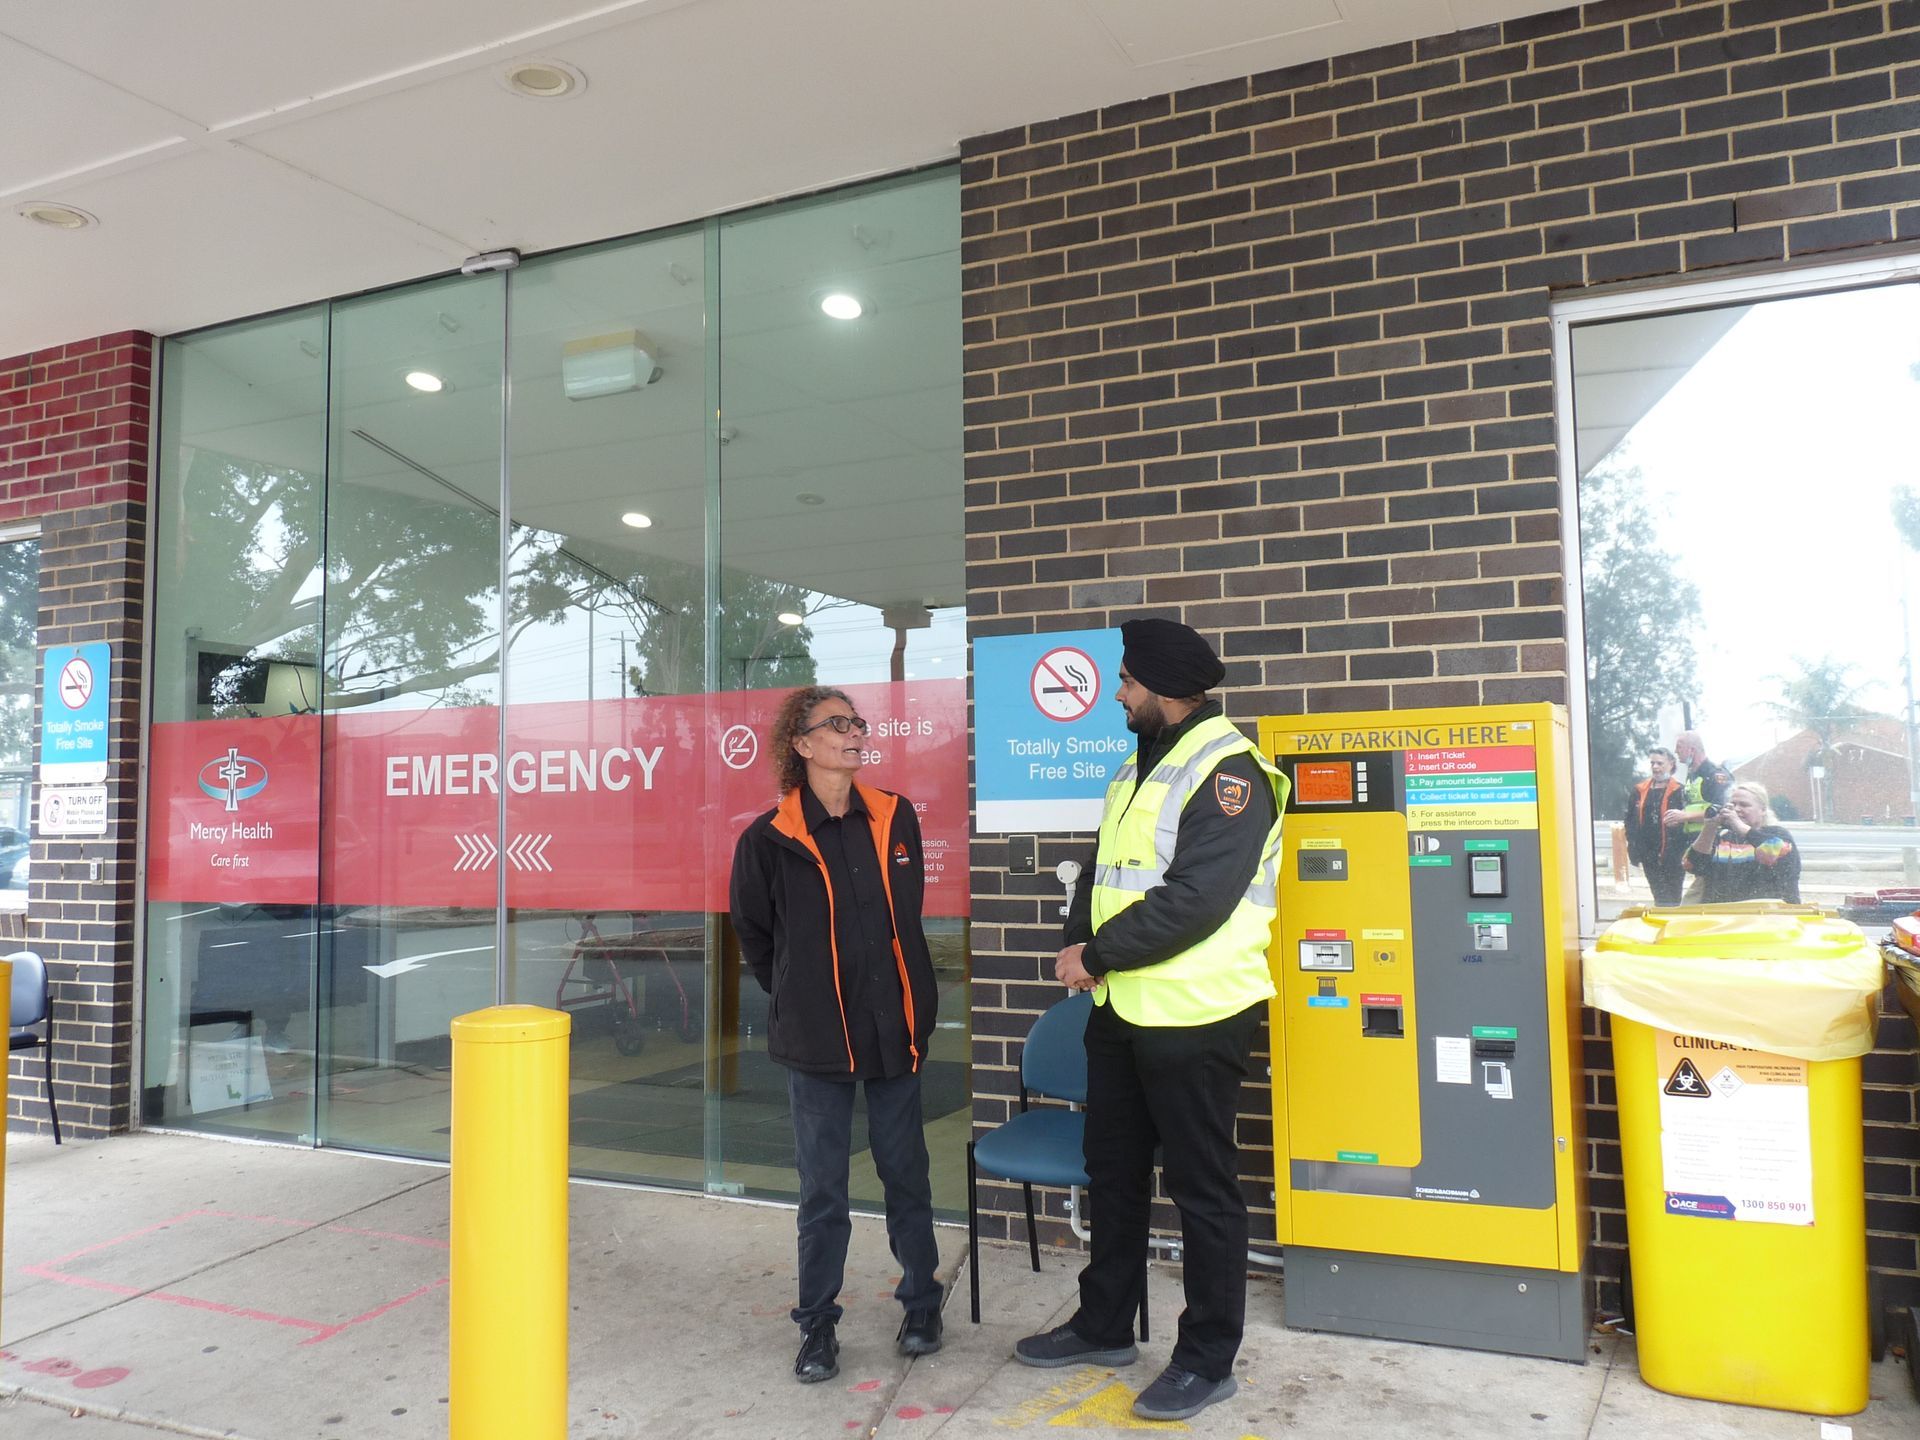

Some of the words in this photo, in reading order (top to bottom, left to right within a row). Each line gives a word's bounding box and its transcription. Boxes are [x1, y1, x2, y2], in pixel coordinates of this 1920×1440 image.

[46, 721, 73, 736] Totally
[74, 719, 104, 732] Smoke
[878, 717, 911, 737] site
[918, 716, 933, 736] is
[55, 737, 75, 750] Free
[77, 736, 94, 749] Site
[1297, 733, 1334, 751] PAY
[1448, 725, 1508, 745] HERE
[1007, 738, 1061, 759] Totally
[1066, 736, 1128, 754] Smoke
[861, 750, 882, 765] ee
[1418, 752, 1440, 760] Insert
[1441, 751, 1466, 759] Ticket
[386, 746, 664, 796] EMERGENCY
[1029, 763, 1067, 780] Free
[1073, 761, 1106, 779] Site
[1418, 762, 1440, 771] Insert
[1442, 762, 1456, 770] QR
[1457, 761, 1477, 769] code
[1419, 778, 1434, 787] Pay
[1436, 777, 1466, 785] amount
[1467, 776, 1503, 785] indicated
[68, 796, 87, 806] TURN
[89, 795, 103, 805] OFF
[1420, 792, 1446, 801] Collect
[1448, 791, 1469, 800] ticket
[1480, 791, 1495, 799] exit
[1511, 791, 1529, 801] park
[1420, 810, 1434, 818] For
[1435, 809, 1477, 817] assistance
[1420, 820, 1442, 828] press
[1458, 818, 1492, 826] intercom
[1494, 817, 1520, 825] button
[190, 822, 228, 845] Mercy
[232, 821, 273, 839] Health
[210, 853, 231, 867] Care
[232, 853, 250, 870] first
[936, 863, 945, 871] to
[1741, 1199, 1765, 1209] 1300
[1767, 1201, 1786, 1210] 850
[1788, 1202, 1807, 1212] 901
